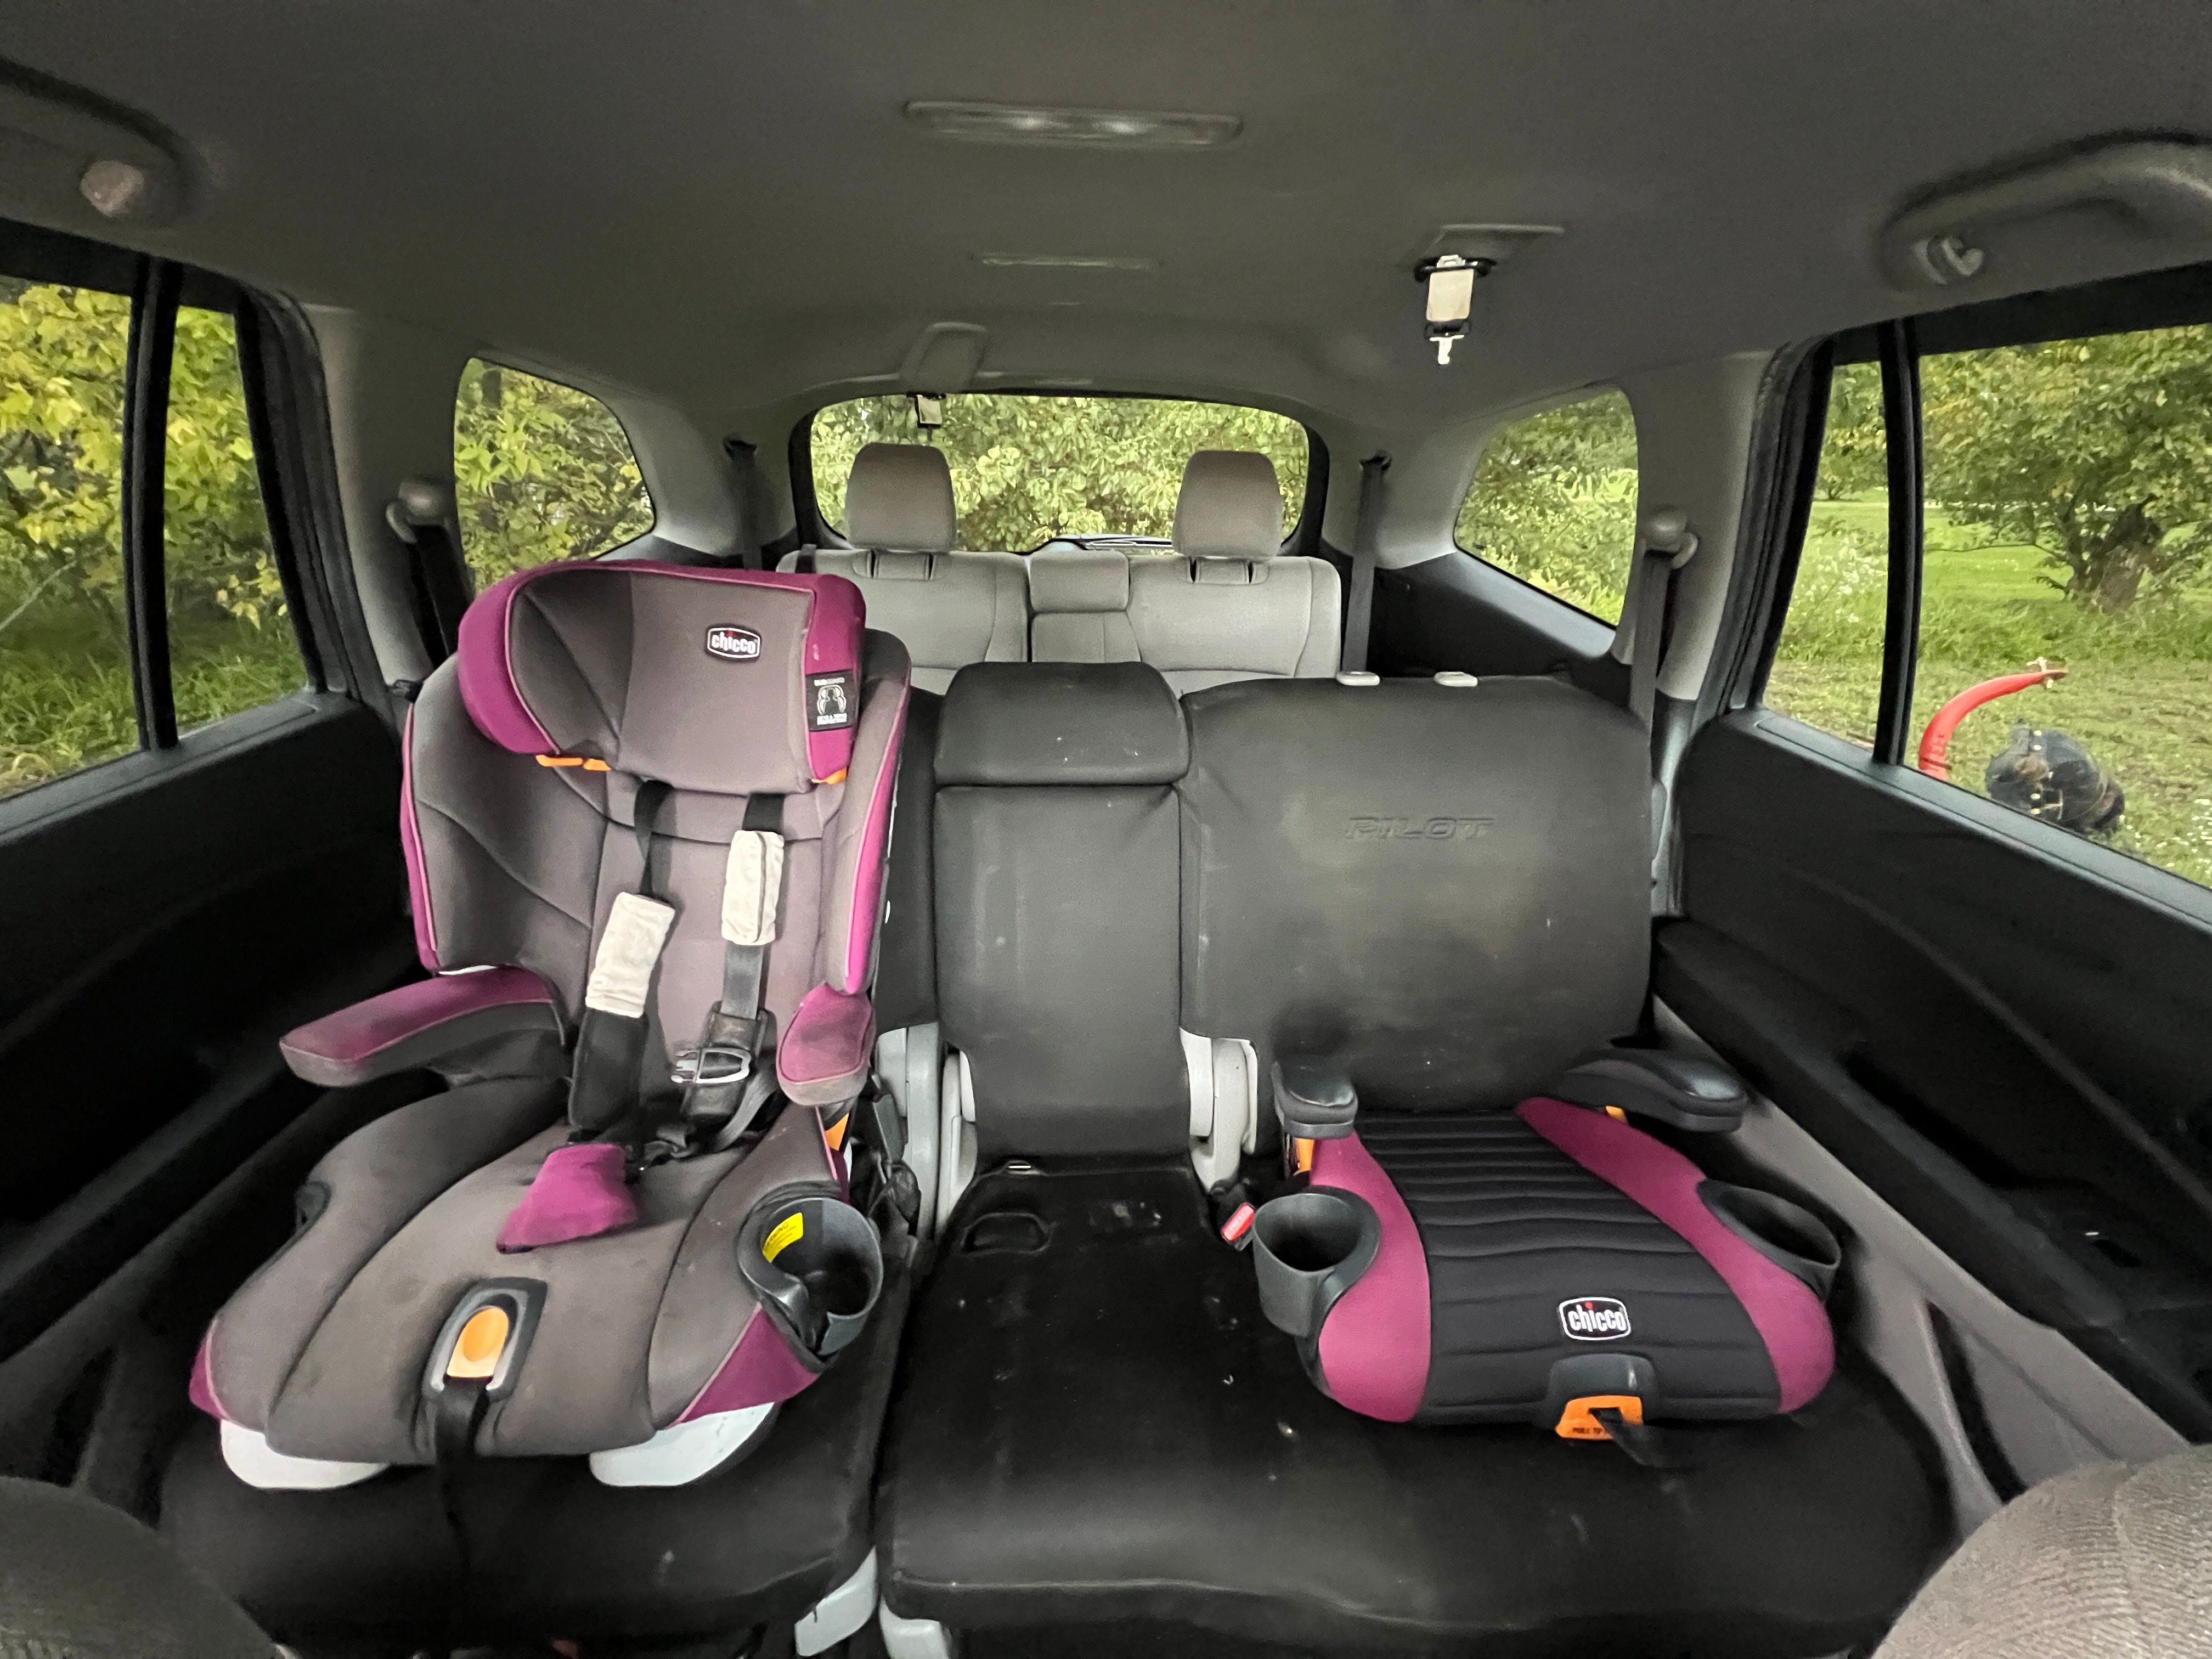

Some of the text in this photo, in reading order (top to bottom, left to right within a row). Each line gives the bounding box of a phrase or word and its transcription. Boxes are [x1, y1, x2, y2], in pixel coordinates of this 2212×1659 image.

[711, 630, 757, 654] chicco
[1345, 816, 1495, 840] PILOT
[1567, 1301, 1627, 1332] chicco
